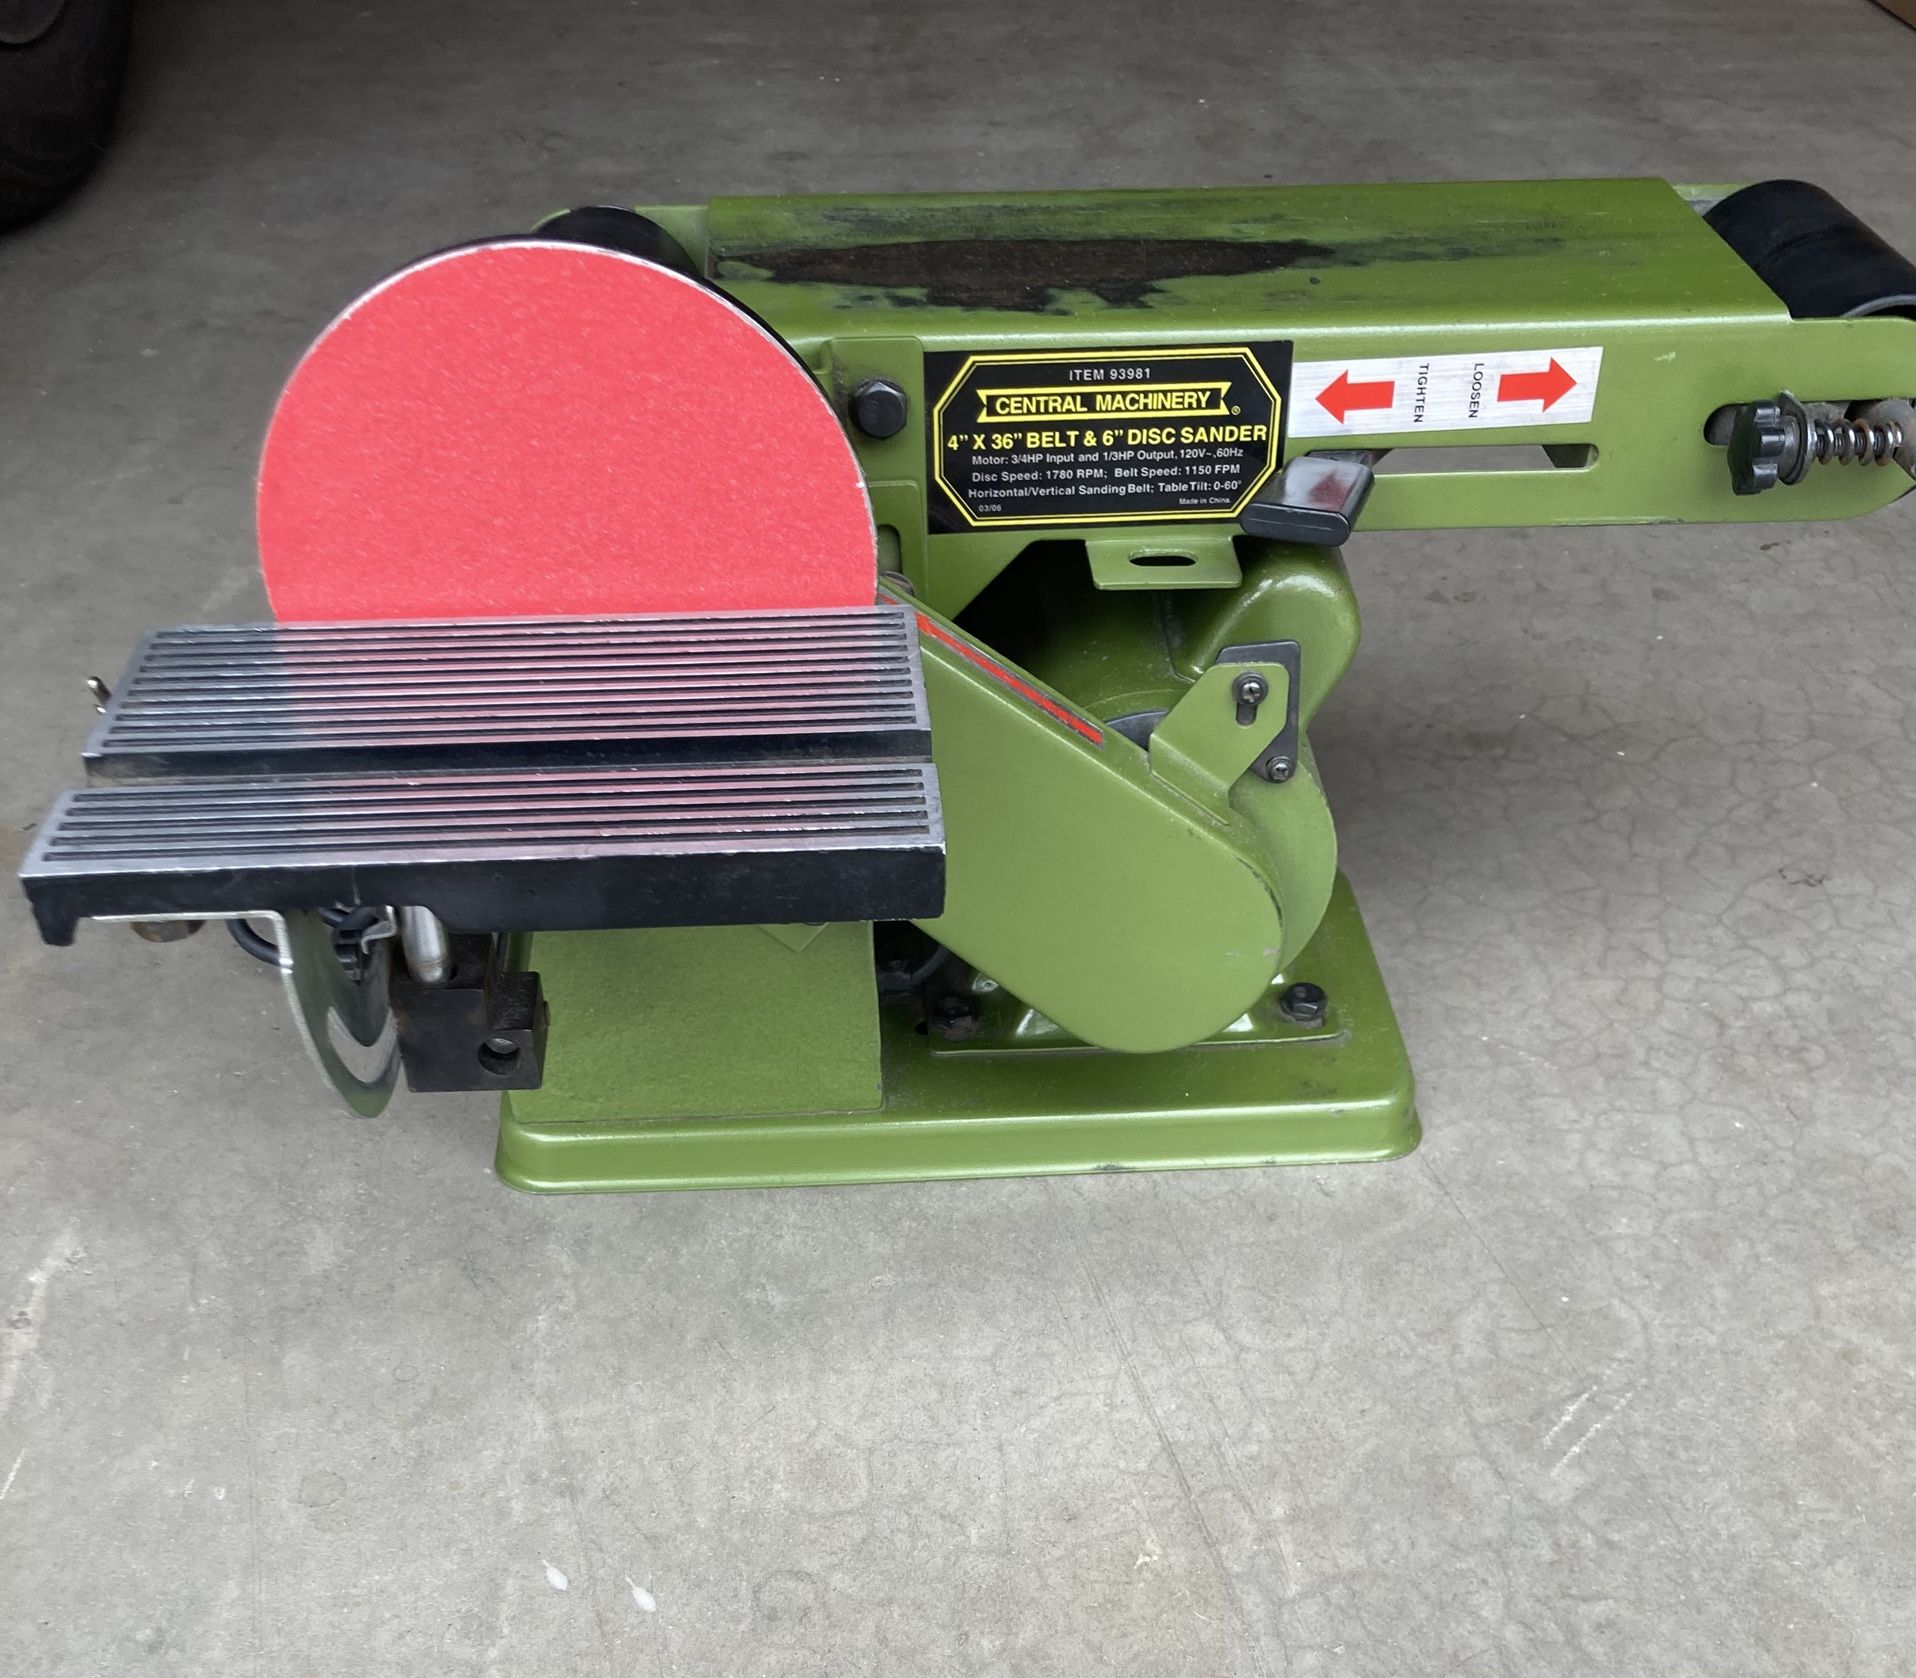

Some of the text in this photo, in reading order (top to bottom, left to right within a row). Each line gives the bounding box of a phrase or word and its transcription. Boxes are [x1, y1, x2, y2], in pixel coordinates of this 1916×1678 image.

[1069, 368, 1150, 381] ITEM 93981
[1414, 363, 1430, 422] TIGHTEN
[1468, 363, 1484, 418] LOOSEN
[996, 391, 1210, 414] CENTRAL MACHINERY
[972, 434, 986, 450] X
[1026, 431, 1079, 448] BELT
[1083, 430, 1098, 446] &
[1127, 428, 1176, 445] DISC
[1180, 425, 1268, 443] SANDER
[972, 455, 1009, 465] Motor:
[1011, 453, 1044, 464] 3/4HP
[1046, 453, 1074, 464] Input
[1078, 452, 1099, 462] and
[1102, 451, 1134, 461] 1/3HP
[972, 464, 1240, 482] Disc Speed: 1780 RPM; Belt Speed: 1150 FPM
[968, 480, 1242, 498] Horizontal/Vertical Sanding Belt; Table Tilt: 0-60°
